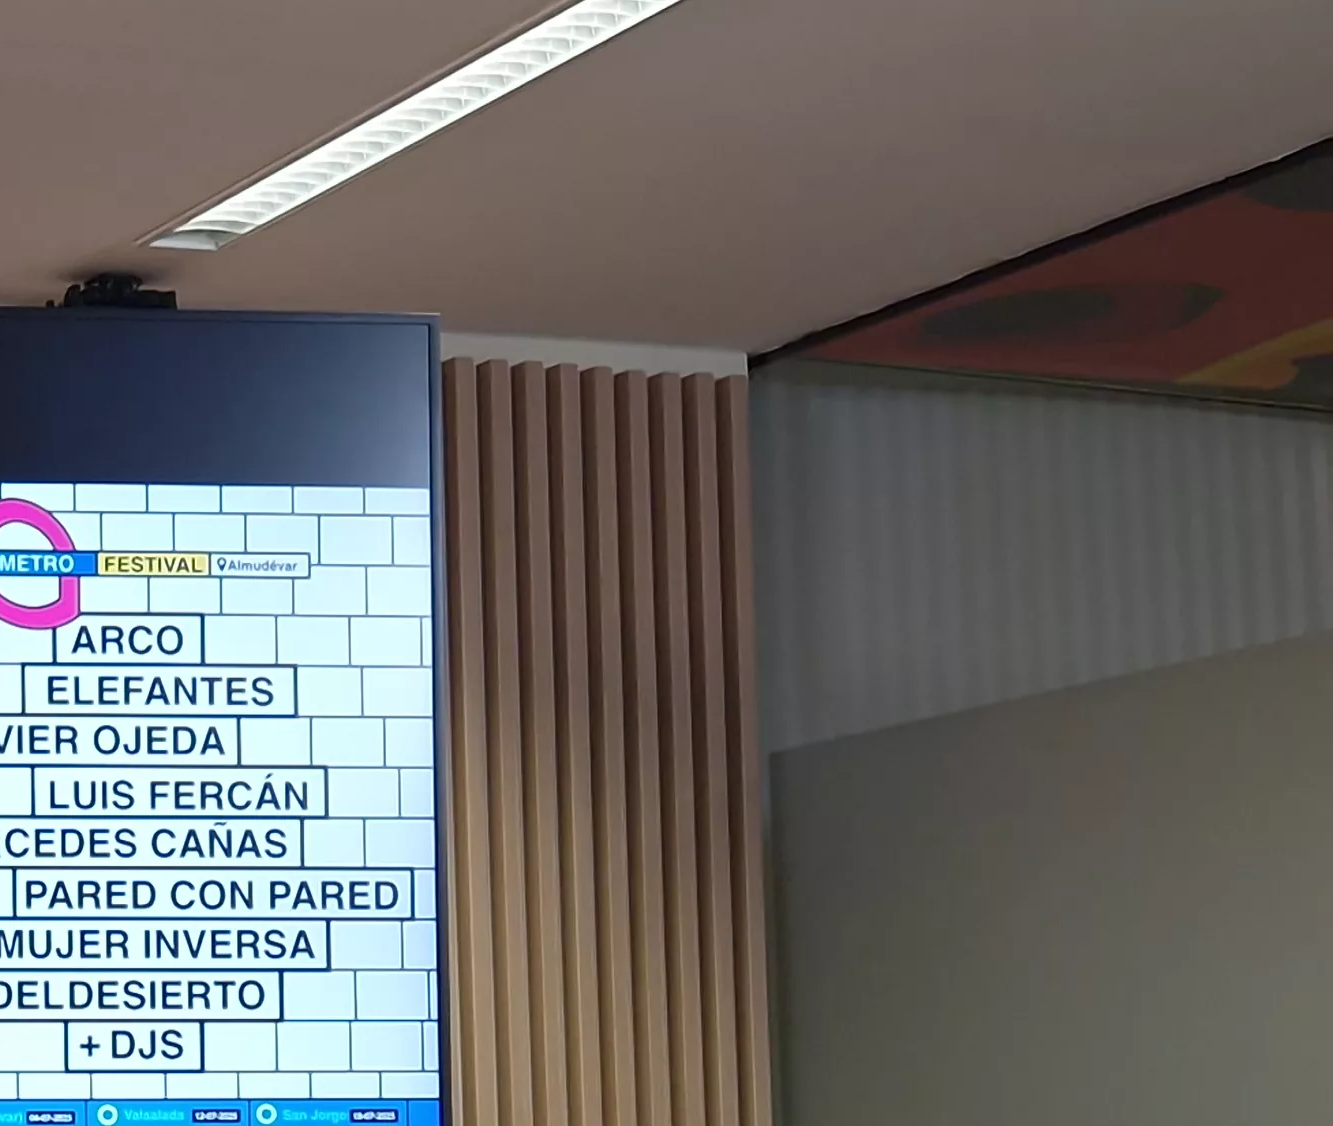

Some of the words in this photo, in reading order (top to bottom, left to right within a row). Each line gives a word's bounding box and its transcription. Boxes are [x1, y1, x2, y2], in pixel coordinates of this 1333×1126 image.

[104, 555, 204, 574] FESTIVAL
[228, 556, 299, 573] Almudévar
[71, 625, 184, 655] ARCO
[47, 676, 274, 707] ELEFANTES
[93, 725, 225, 756] OJEDA
[49, 781, 135, 810] LUIS
[150, 774, 308, 811] FERCÁN
[151, 822, 287, 859] CAÑAS
[25, 880, 156, 909] PARED
[170, 880, 254, 910] CON
[269, 880, 399, 910] PARED
[144, 929, 315, 960] INVERSA
[111, 1030, 184, 1060] DJS
